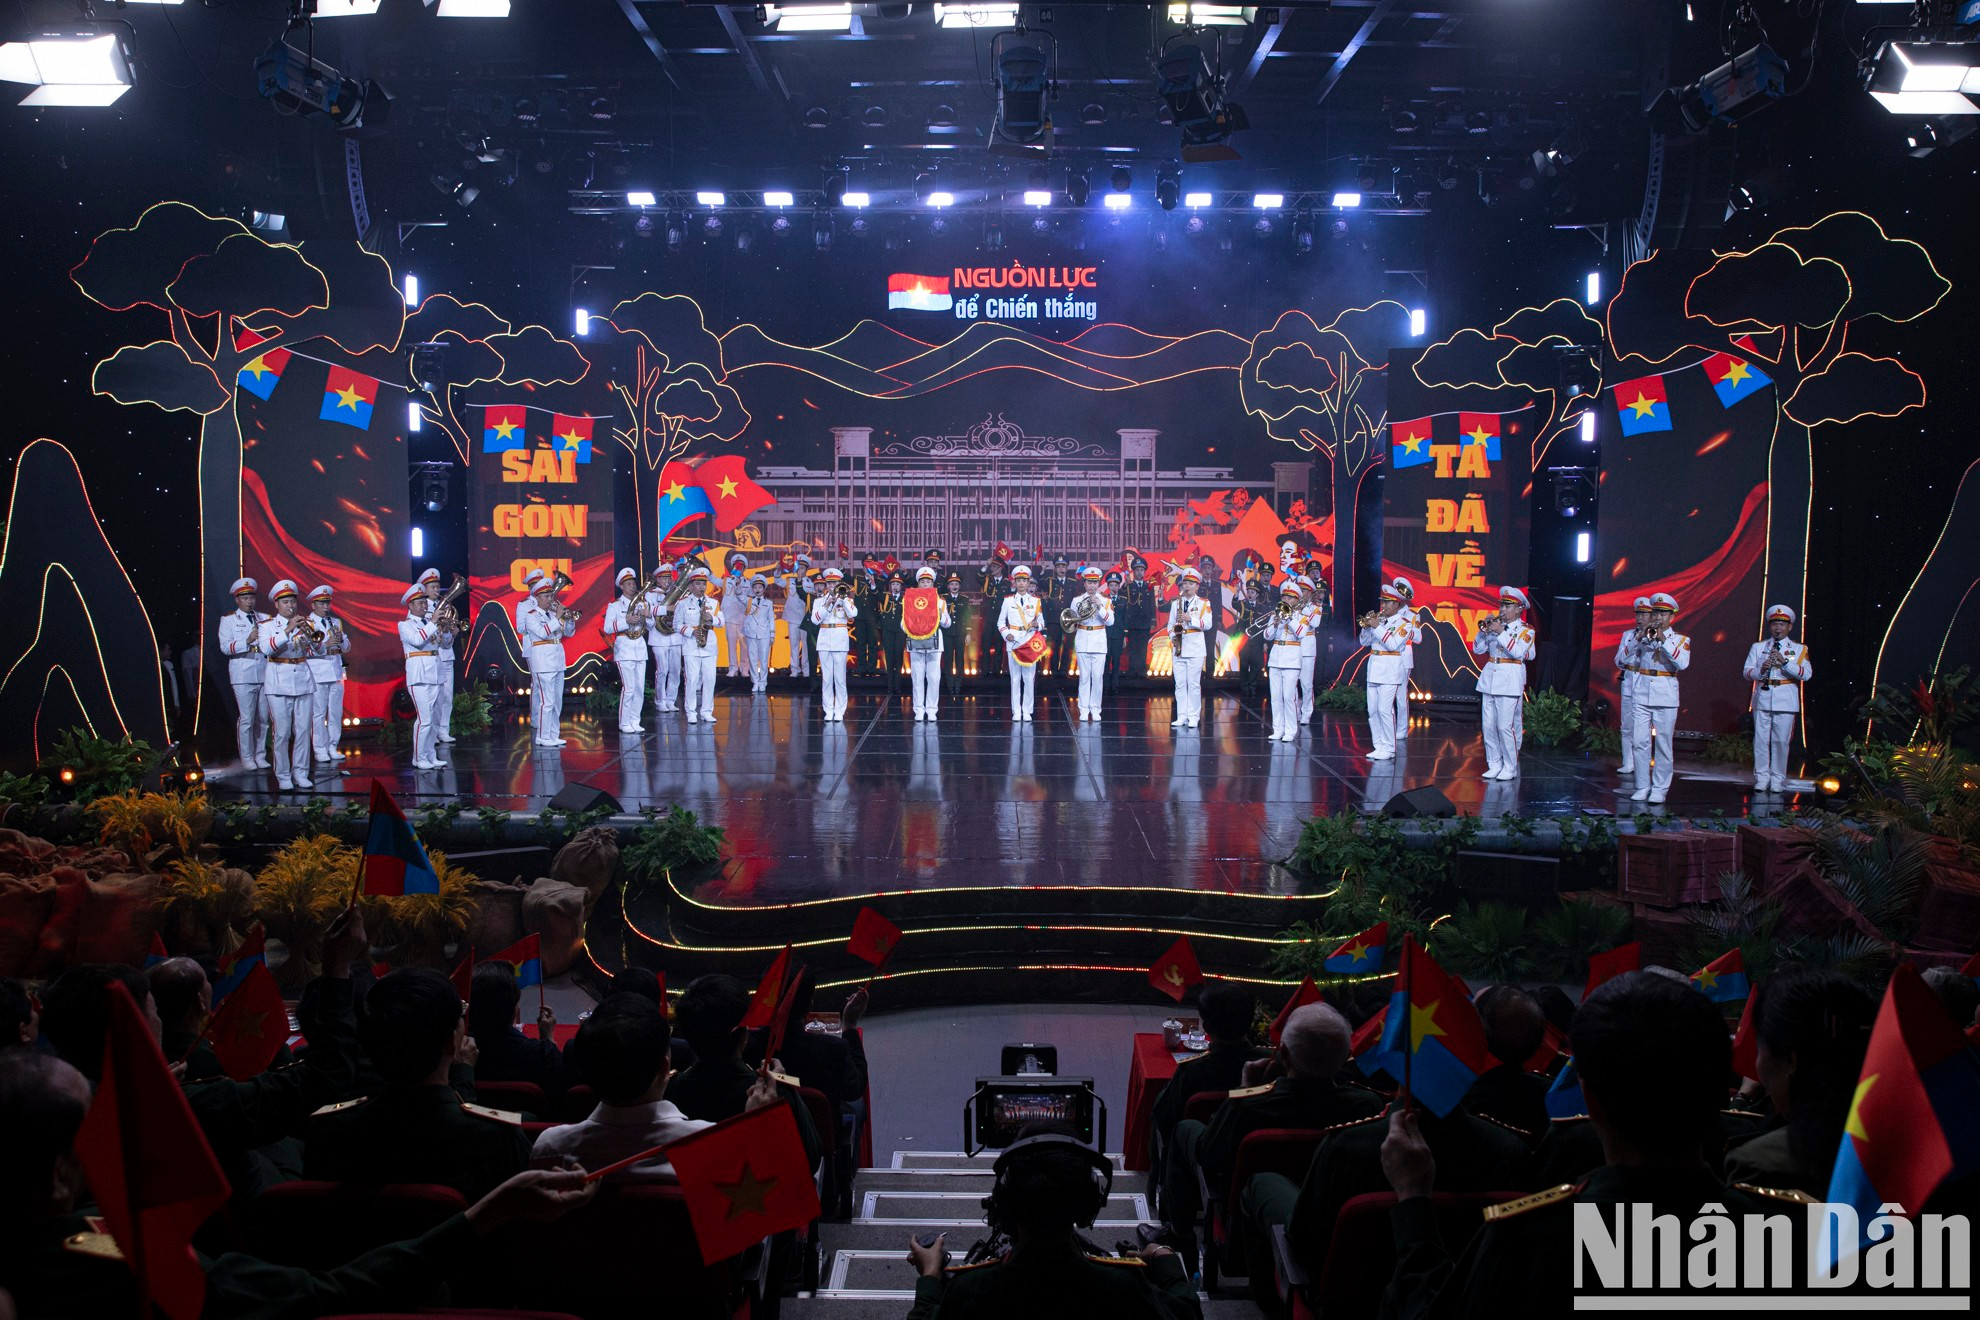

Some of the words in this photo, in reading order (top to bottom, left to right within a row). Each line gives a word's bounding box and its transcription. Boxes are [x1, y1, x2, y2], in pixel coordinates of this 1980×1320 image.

[954, 259, 1045, 288] NGUỒN
[1050, 267, 1097, 291] LỰC
[955, 293, 979, 318] để
[986, 294, 1038, 319] Chiến
[1045, 293, 1097, 320] thắng
[502, 442, 577, 483] SÀI
[1428, 444, 1491, 478] TA
[493, 496, 588, 537] GÒN
[1426, 493, 1490, 533] ĐÃ
[1426, 540, 1485, 587] VỀ
